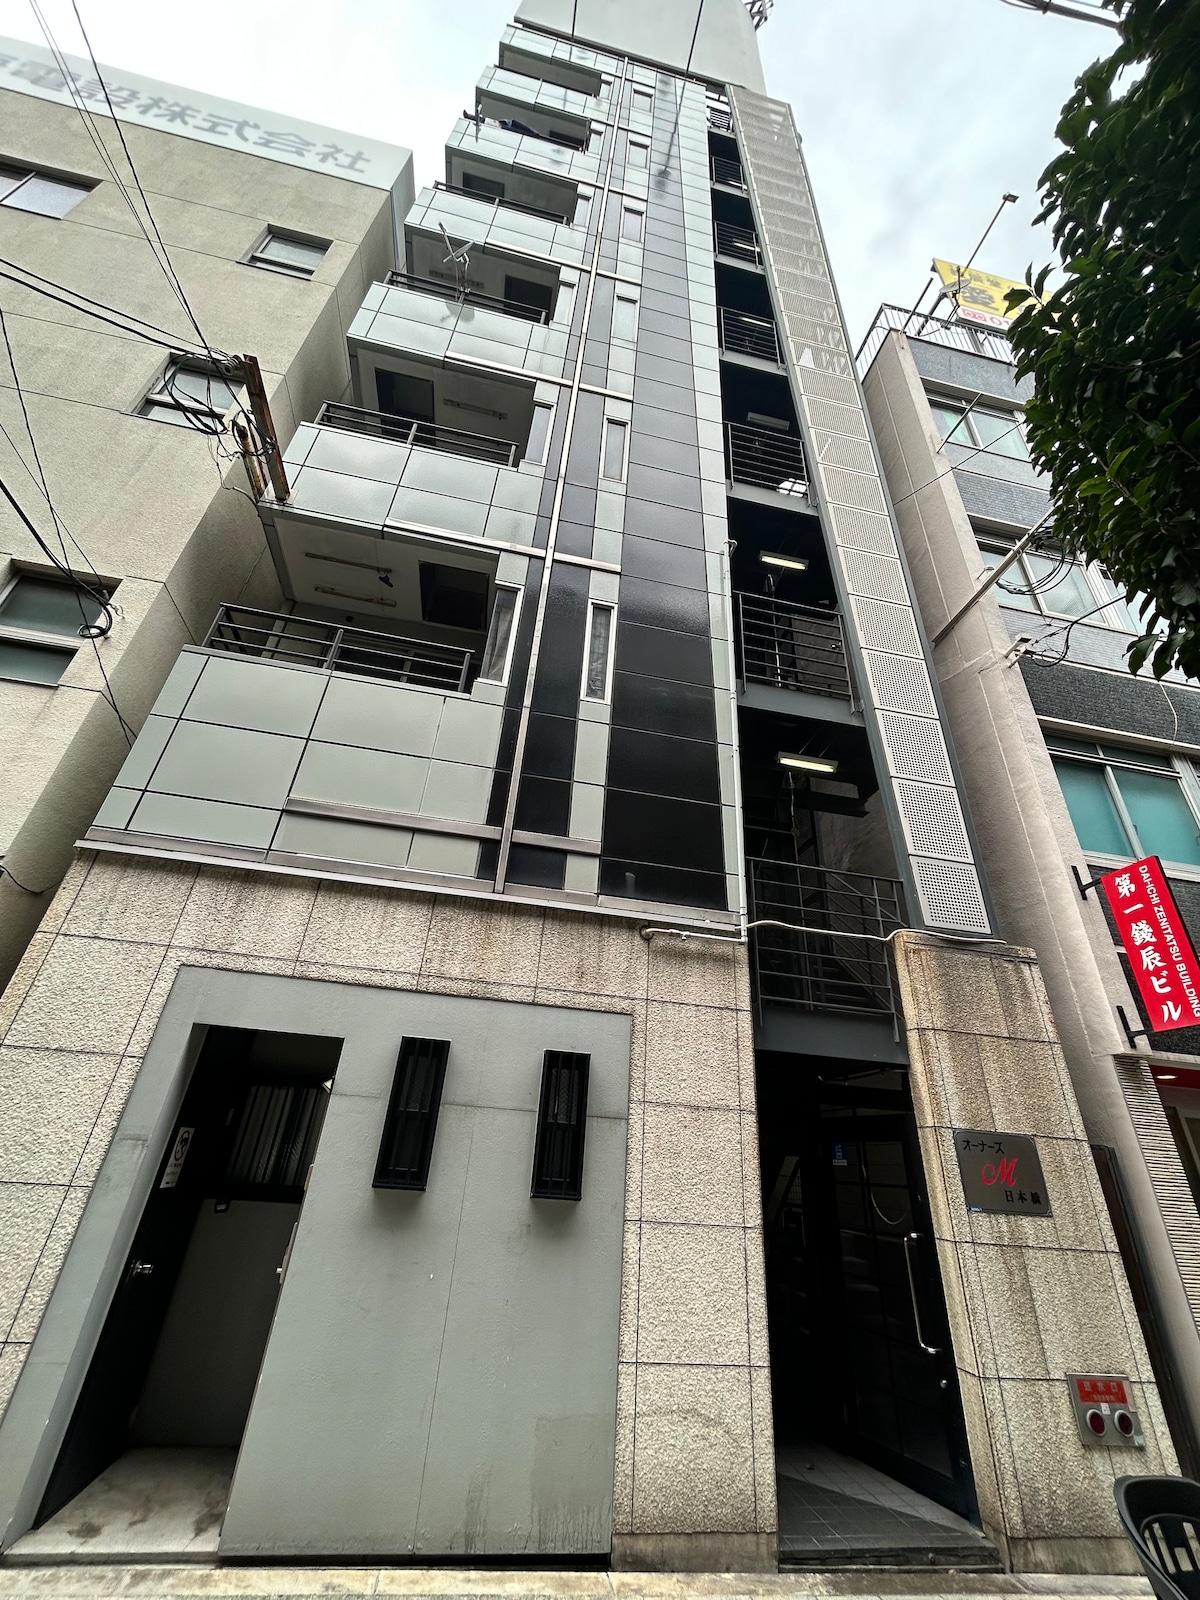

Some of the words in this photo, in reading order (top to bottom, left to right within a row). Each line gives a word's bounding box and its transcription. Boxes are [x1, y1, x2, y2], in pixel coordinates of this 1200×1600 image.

[1138, 864, 1161, 905] DAI-ICHI
[1153, 904, 1183, 961] ZENITATSU
[1175, 962, 1200, 1018] BUILDING
[981, 1157, 1019, 1188] M
[1004, 1189, 1042, 1205] 日本橋
